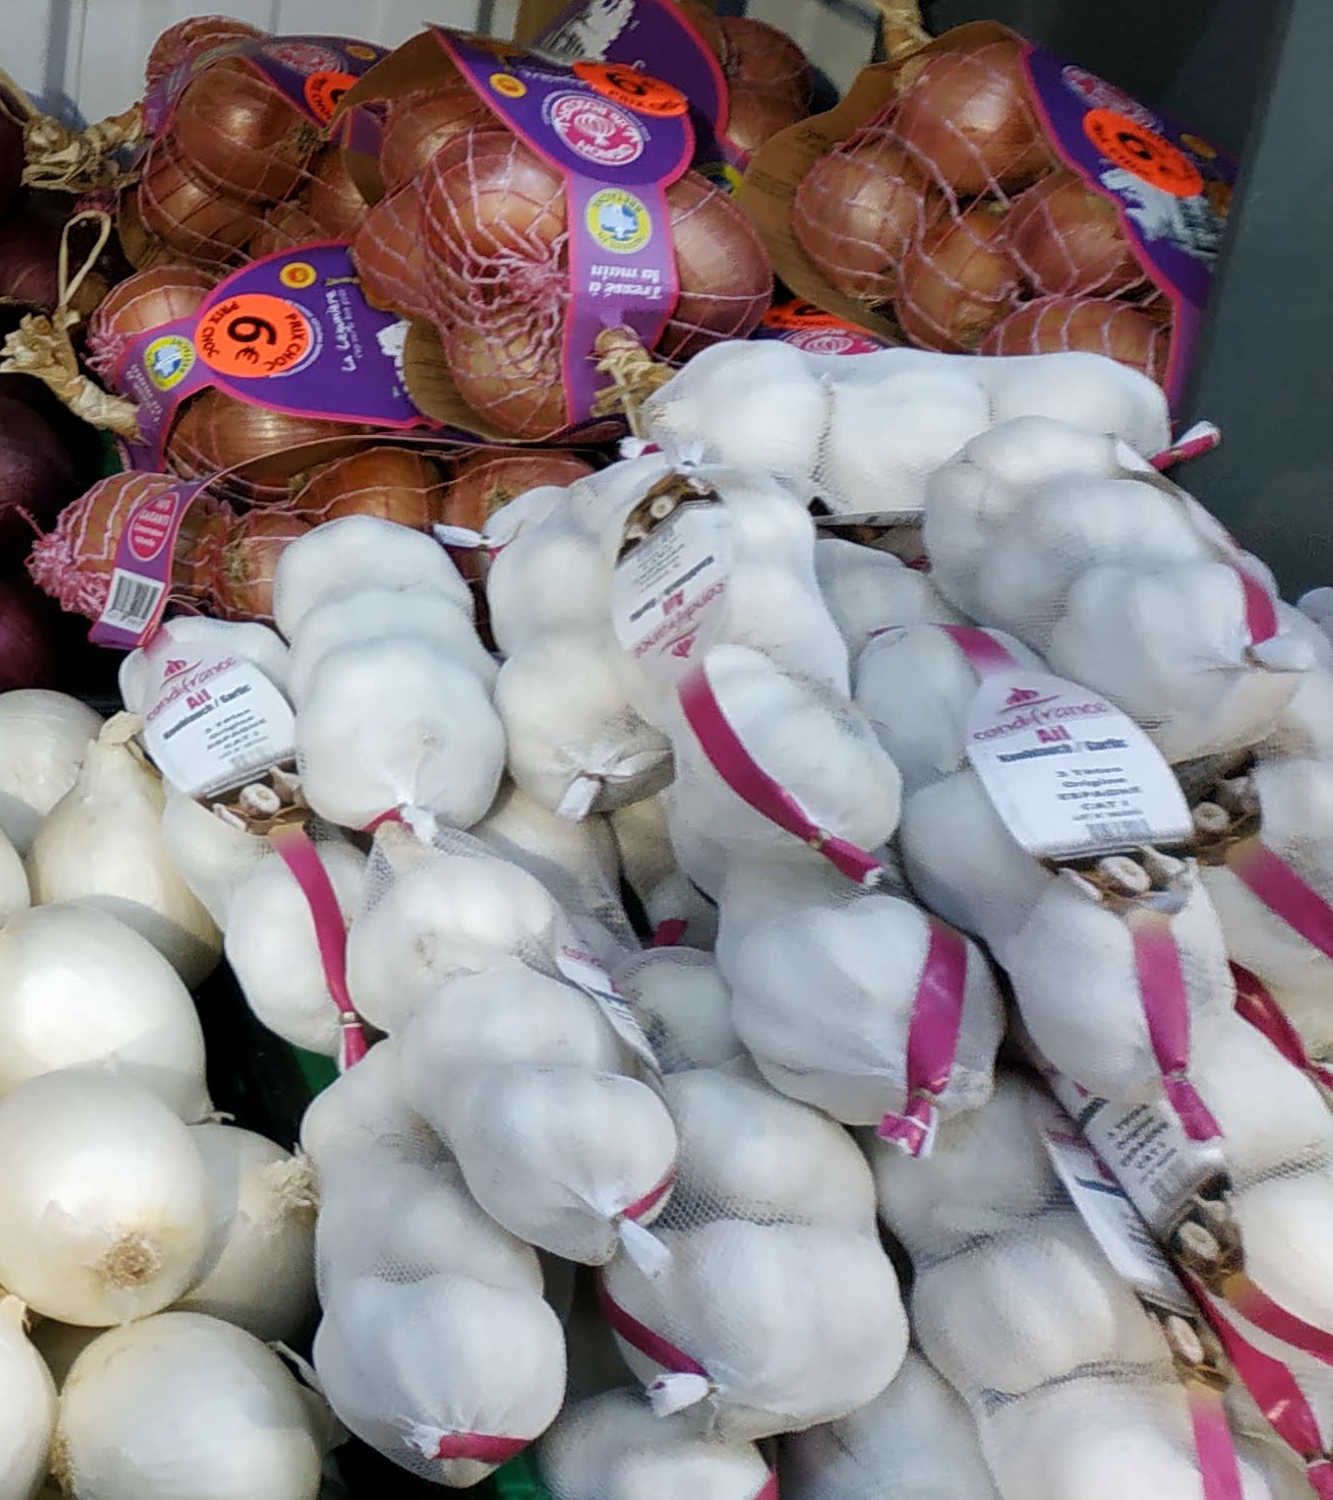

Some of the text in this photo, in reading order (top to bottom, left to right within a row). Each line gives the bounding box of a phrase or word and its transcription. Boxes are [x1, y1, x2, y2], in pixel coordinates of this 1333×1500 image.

[590, 264, 638, 280] main
[201, 301, 240, 358] PRIX CHOC
[263, 313, 307, 371] PRIX CHOC
[186, 688, 213, 710] Ail
[973, 702, 1110, 741] condifrance
[1036, 725, 1072, 743] Ail
